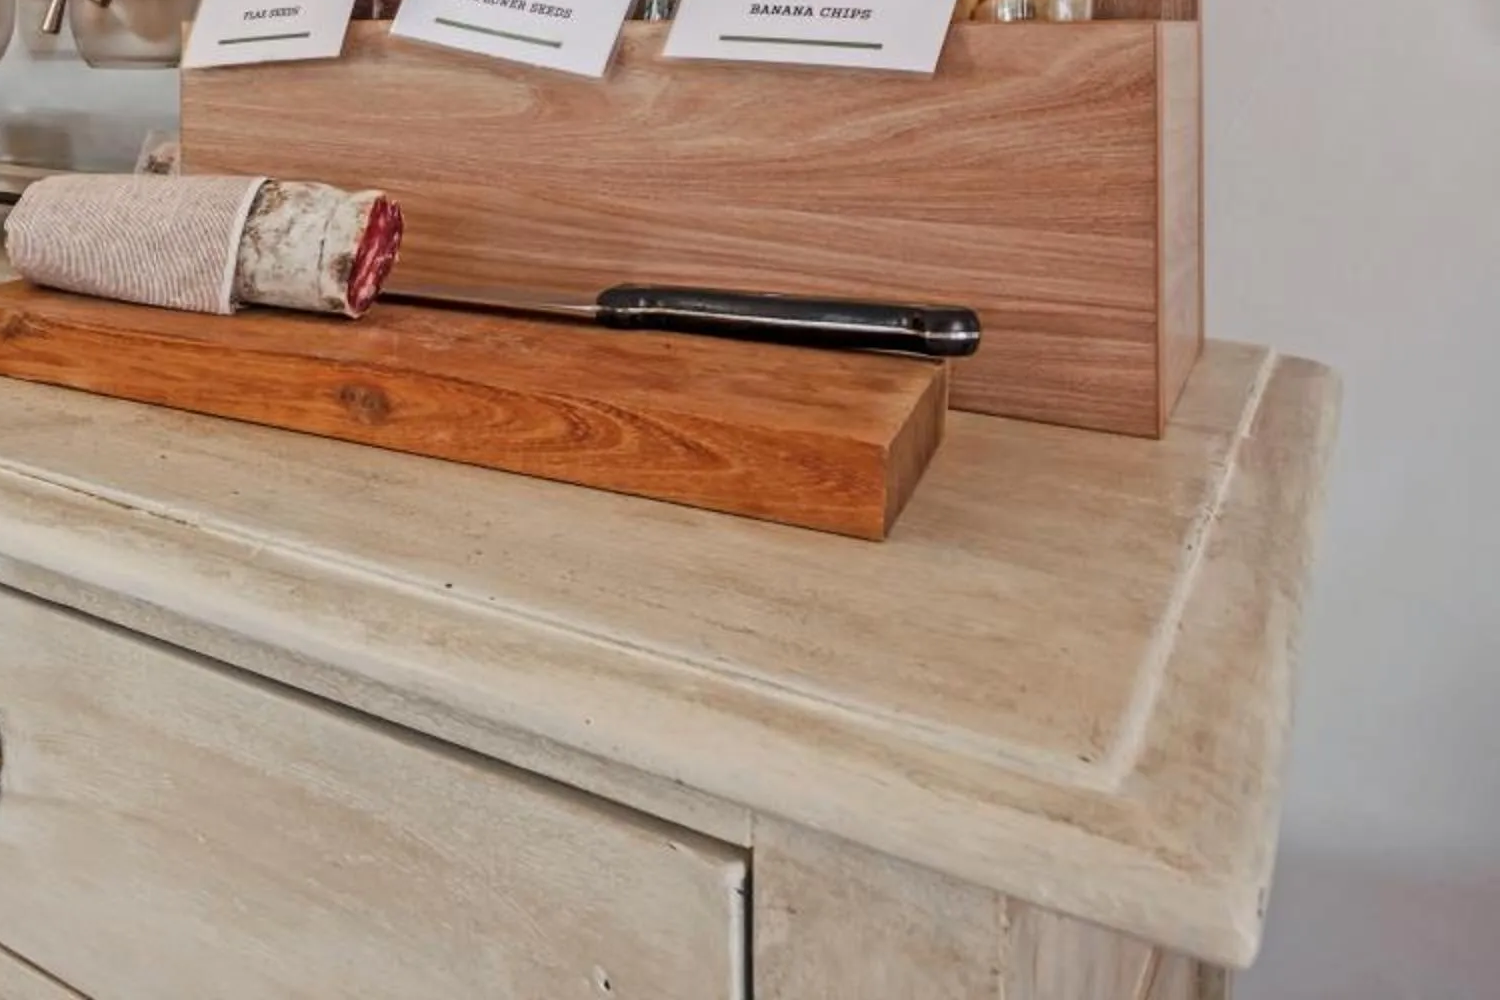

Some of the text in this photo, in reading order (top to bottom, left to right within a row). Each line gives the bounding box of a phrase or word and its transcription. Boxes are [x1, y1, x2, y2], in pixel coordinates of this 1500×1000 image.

[529, 2, 573, 19] SEEDS
[750, 3, 873, 20] BANANA CHIPS
